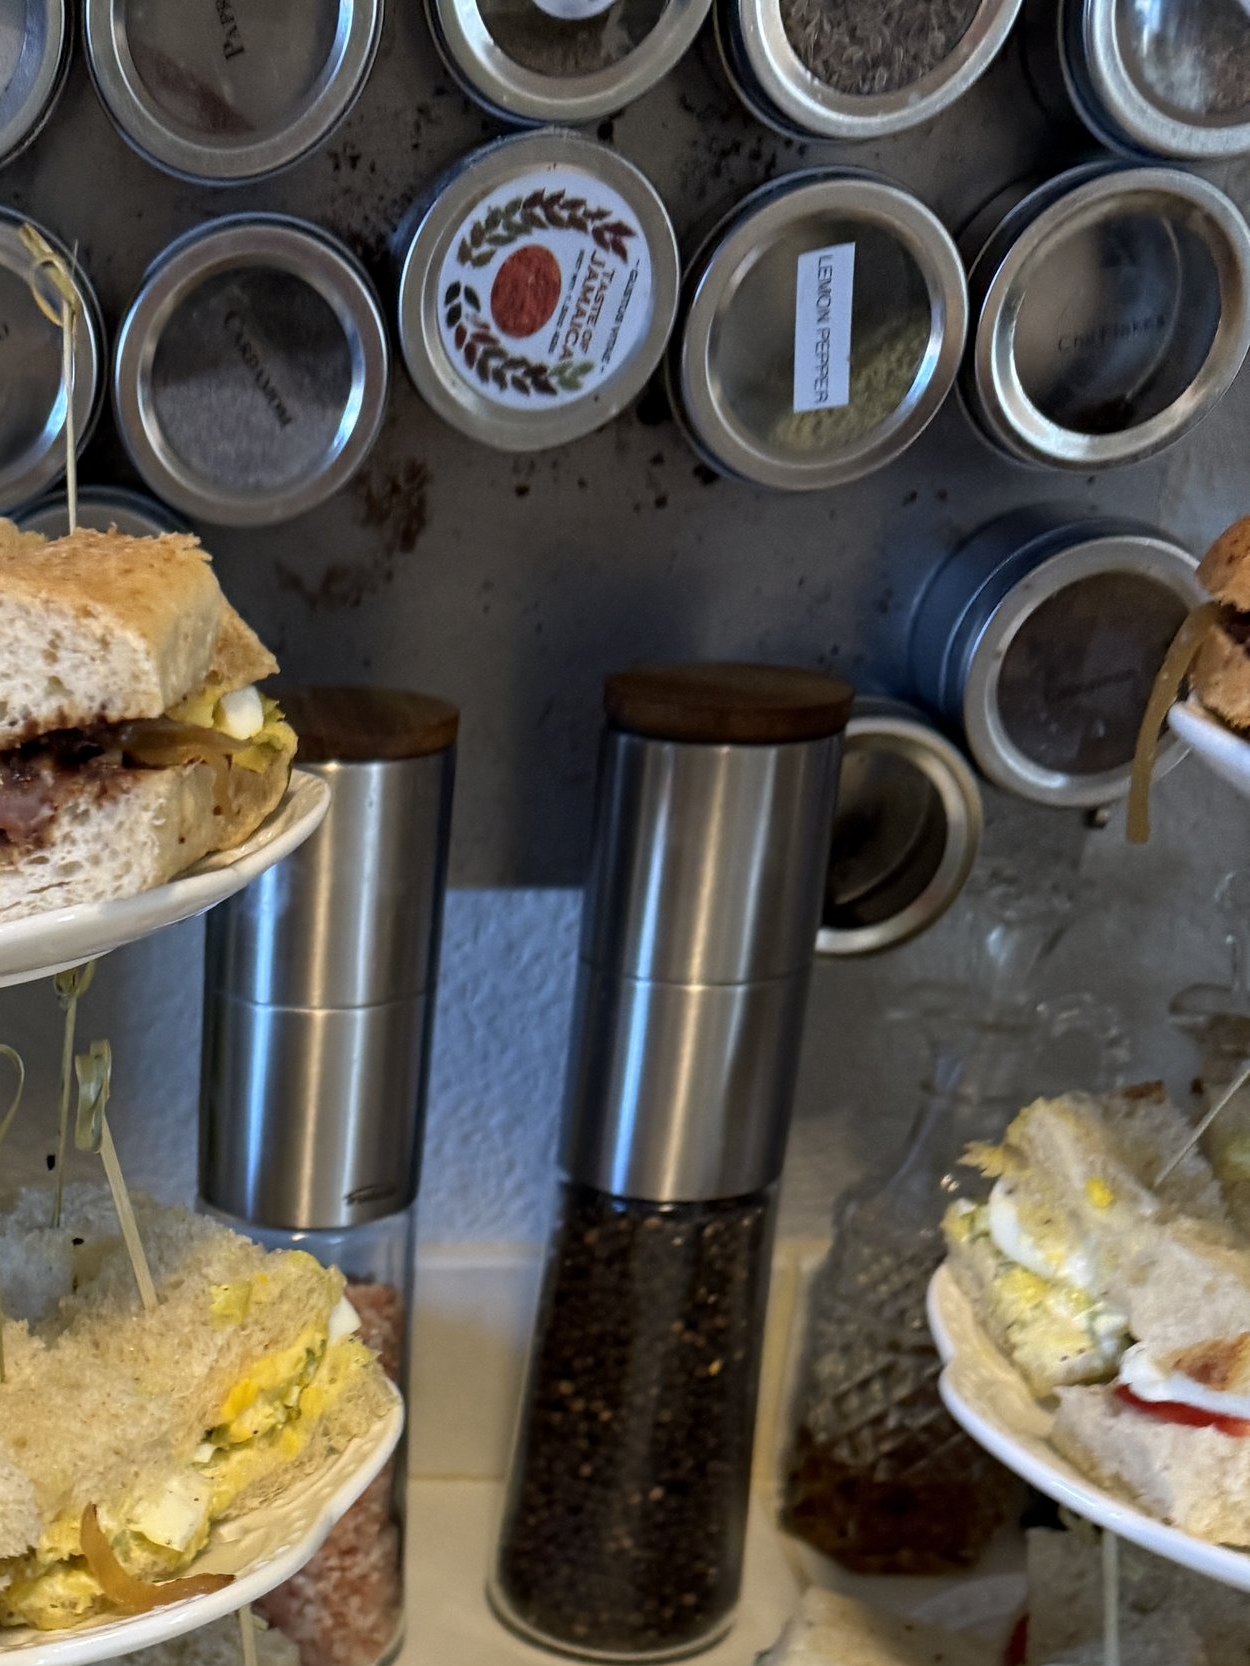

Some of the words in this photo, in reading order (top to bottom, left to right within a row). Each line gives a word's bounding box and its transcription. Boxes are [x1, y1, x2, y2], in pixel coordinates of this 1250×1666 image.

[559, 250, 605, 361] JAMAICA
[587, 268, 615, 326] TASTE
[816, 255, 833, 325] LEMON
[581, 329, 593, 354] OF
[814, 327, 831, 404] PEPPER
